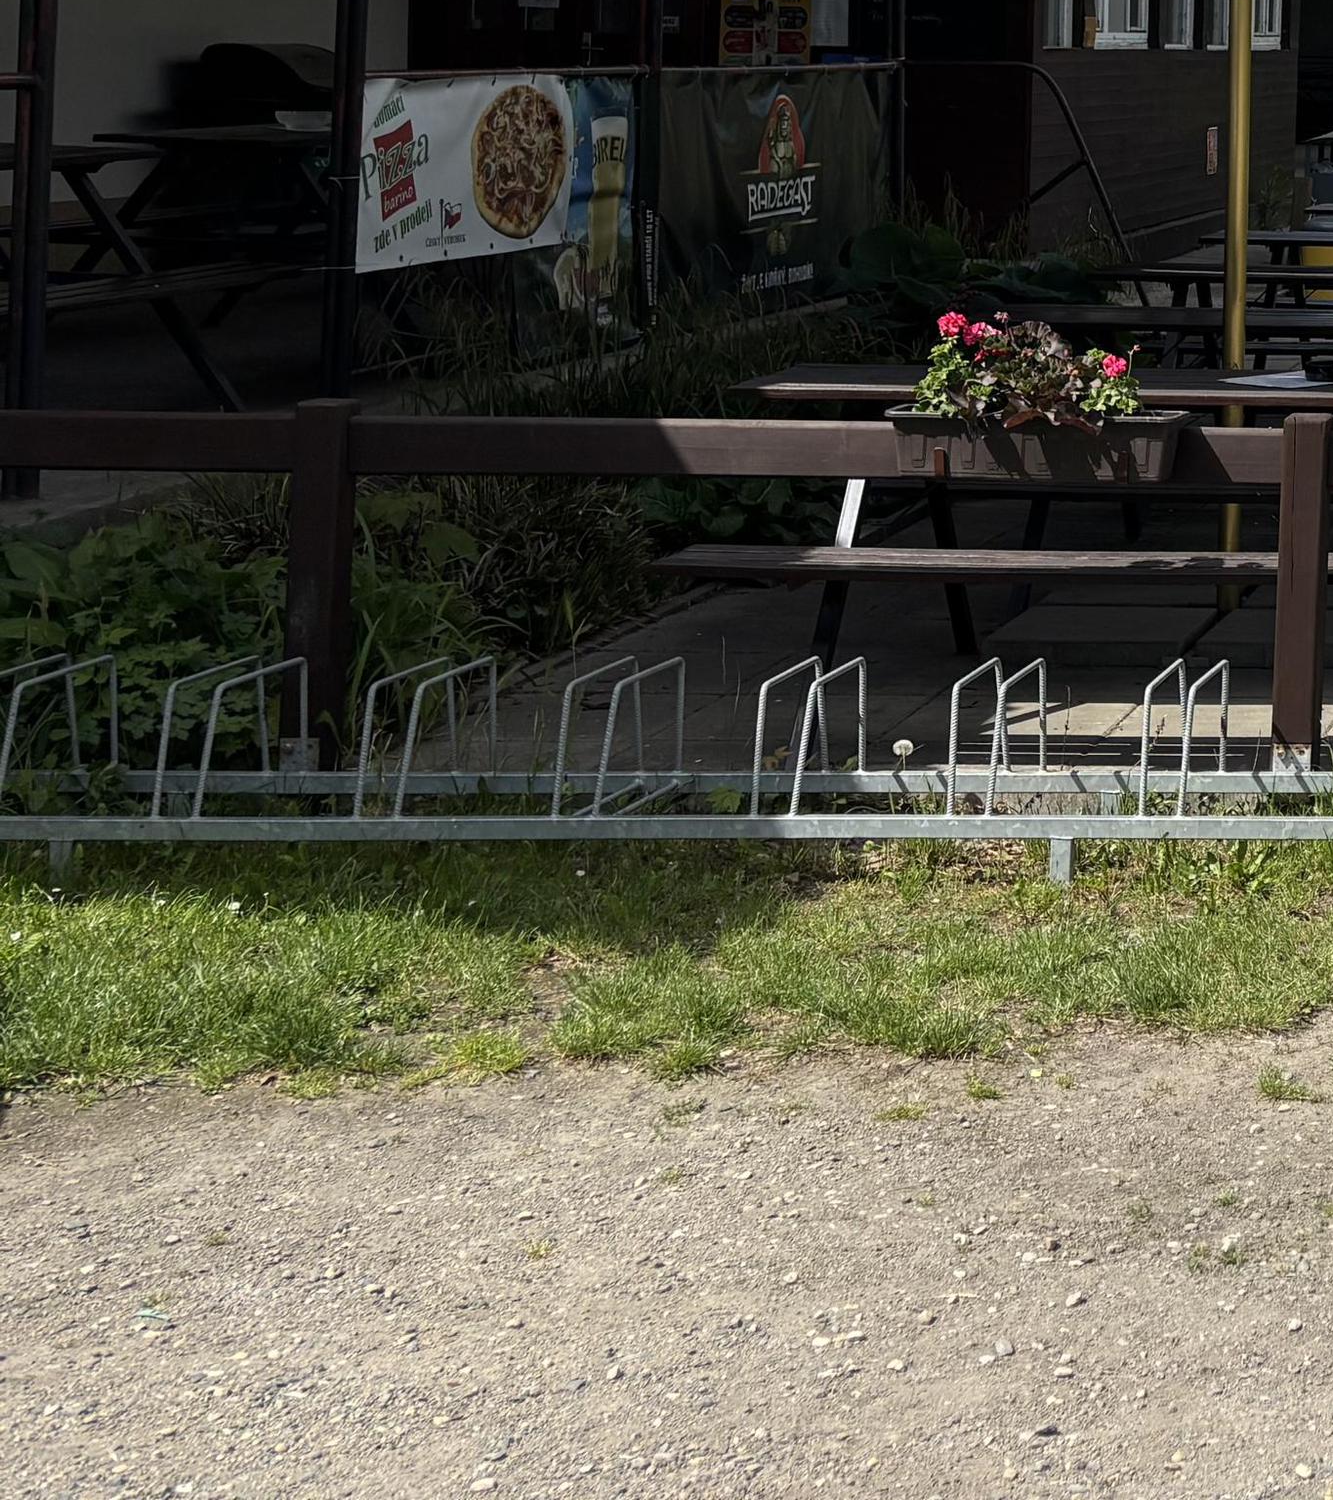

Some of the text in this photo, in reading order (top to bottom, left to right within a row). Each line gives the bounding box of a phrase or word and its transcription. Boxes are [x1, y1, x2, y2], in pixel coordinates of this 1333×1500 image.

[360, 133, 430, 202] Pizza
[383, 185, 415, 213] barino
[747, 175, 817, 222] RADEGAST
[373, 227, 392, 253] zde
[400, 199, 433, 239] prodeji
